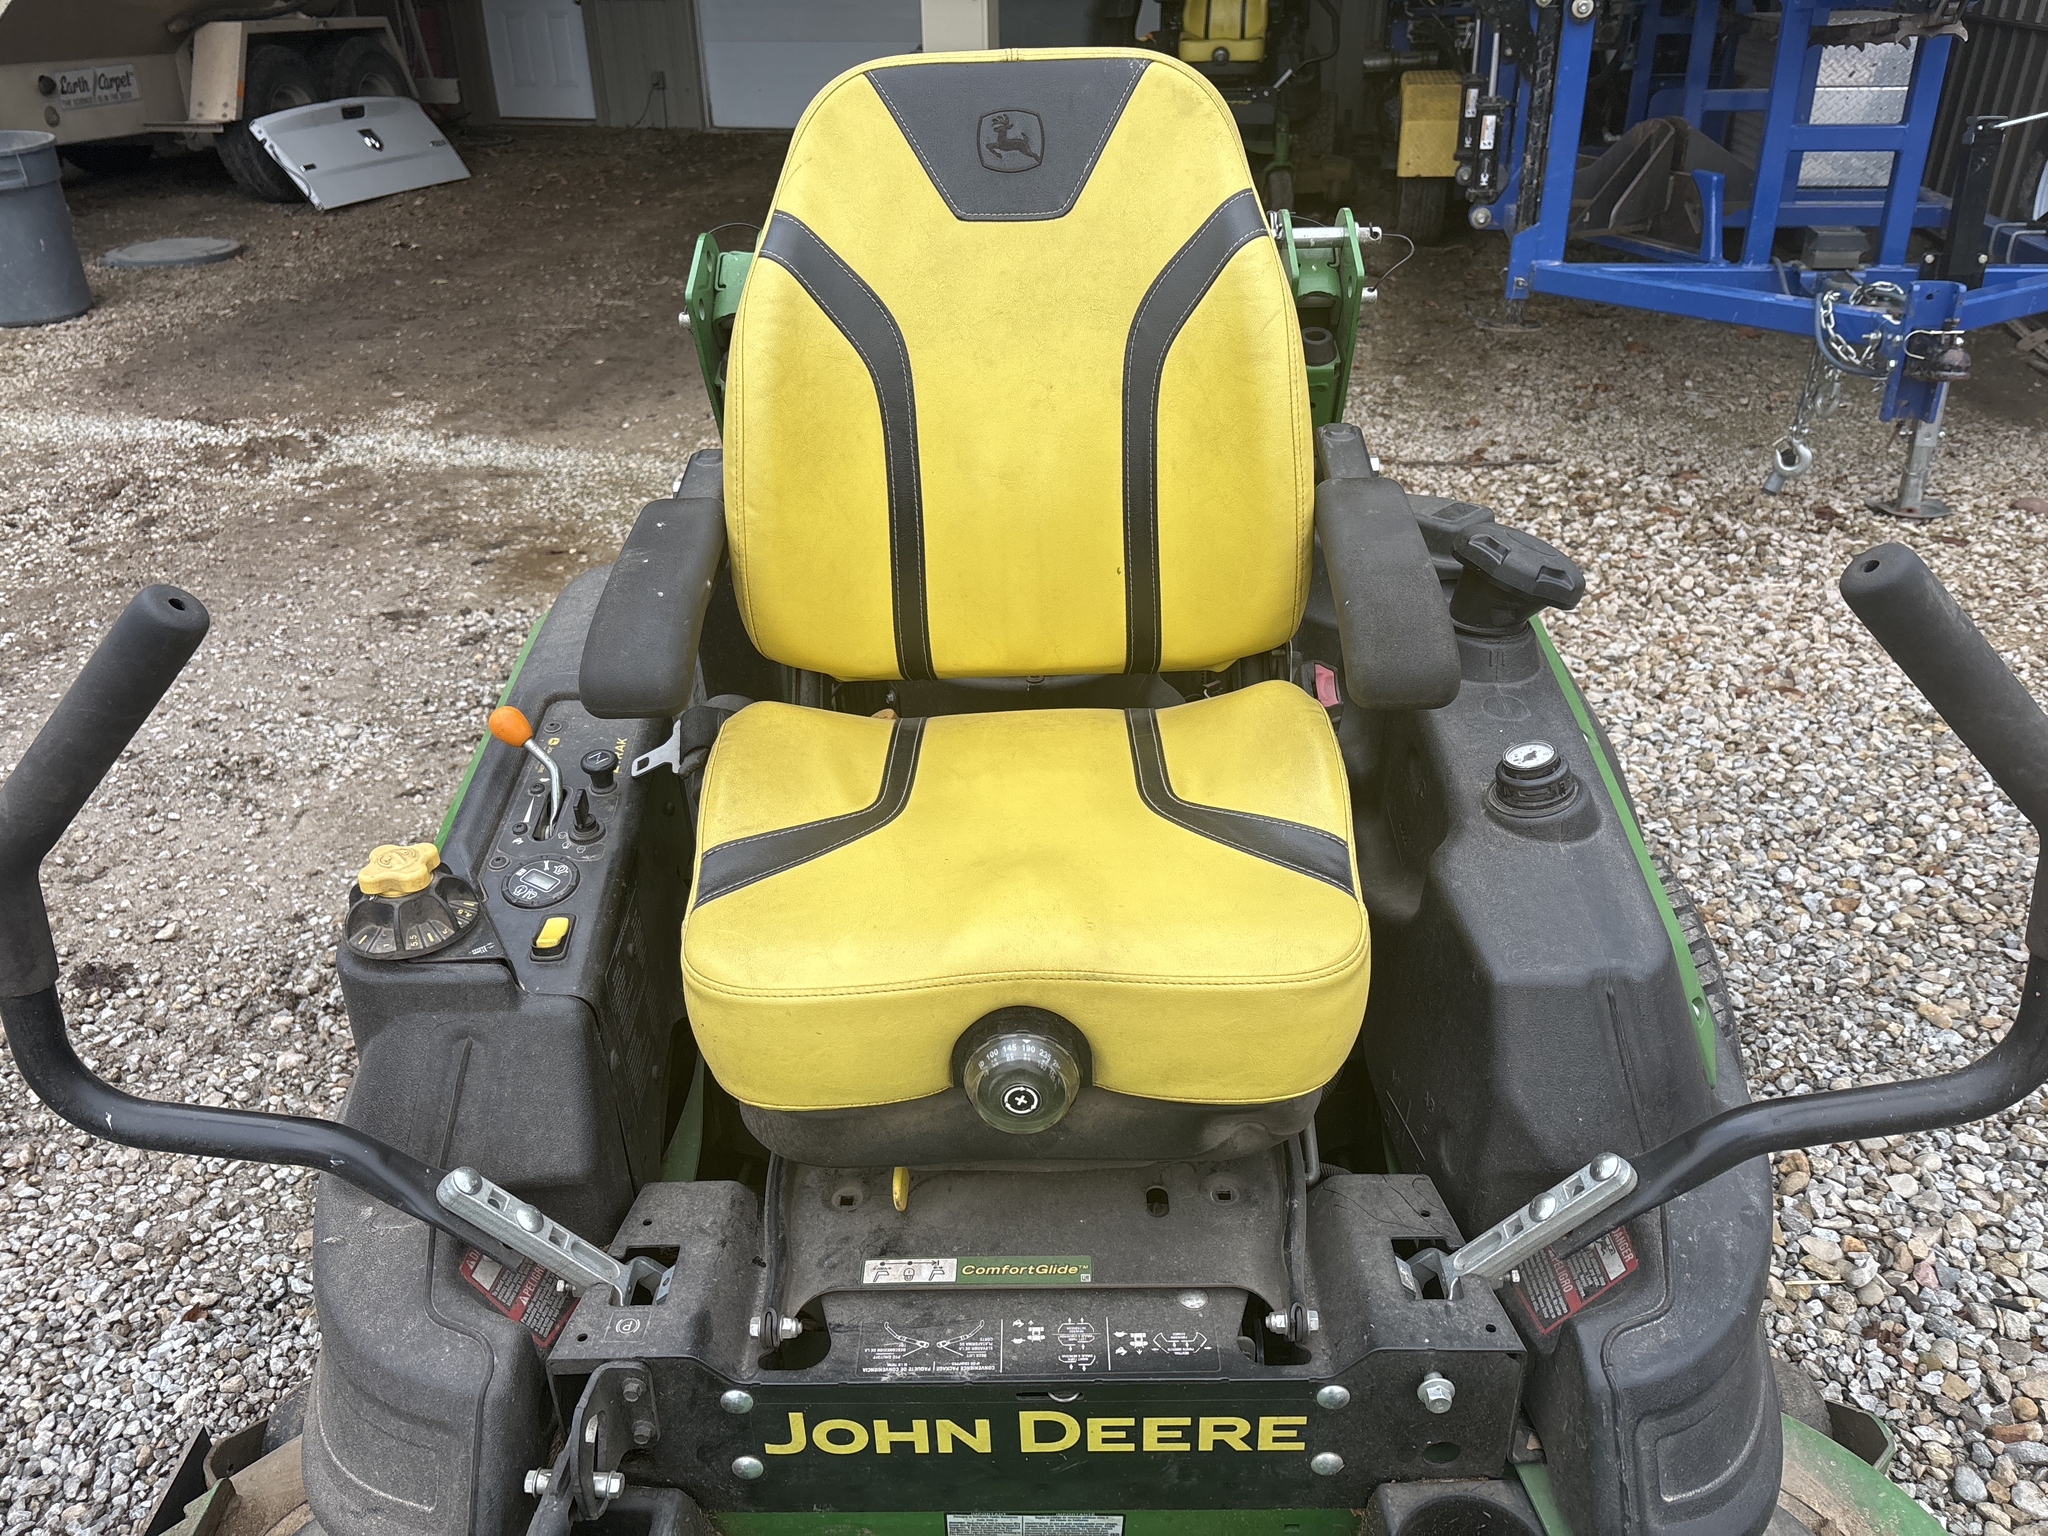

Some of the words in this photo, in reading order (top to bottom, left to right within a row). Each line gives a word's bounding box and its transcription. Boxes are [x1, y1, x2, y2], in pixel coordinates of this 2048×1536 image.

[61, 76, 90, 94] Earth
[98, 70, 131, 92] Carpet
[986, 1049, 998, 1060] 100
[1002, 1044, 1017, 1052] 145
[1022, 1045, 1036, 1053] 190
[1039, 1049, 1051, 1061] 235
[1551, 1256, 1574, 1293] PELIGRO
[764, 1411, 992, 1454] JOHN
[1018, 1410, 1308, 1453] DEERE
